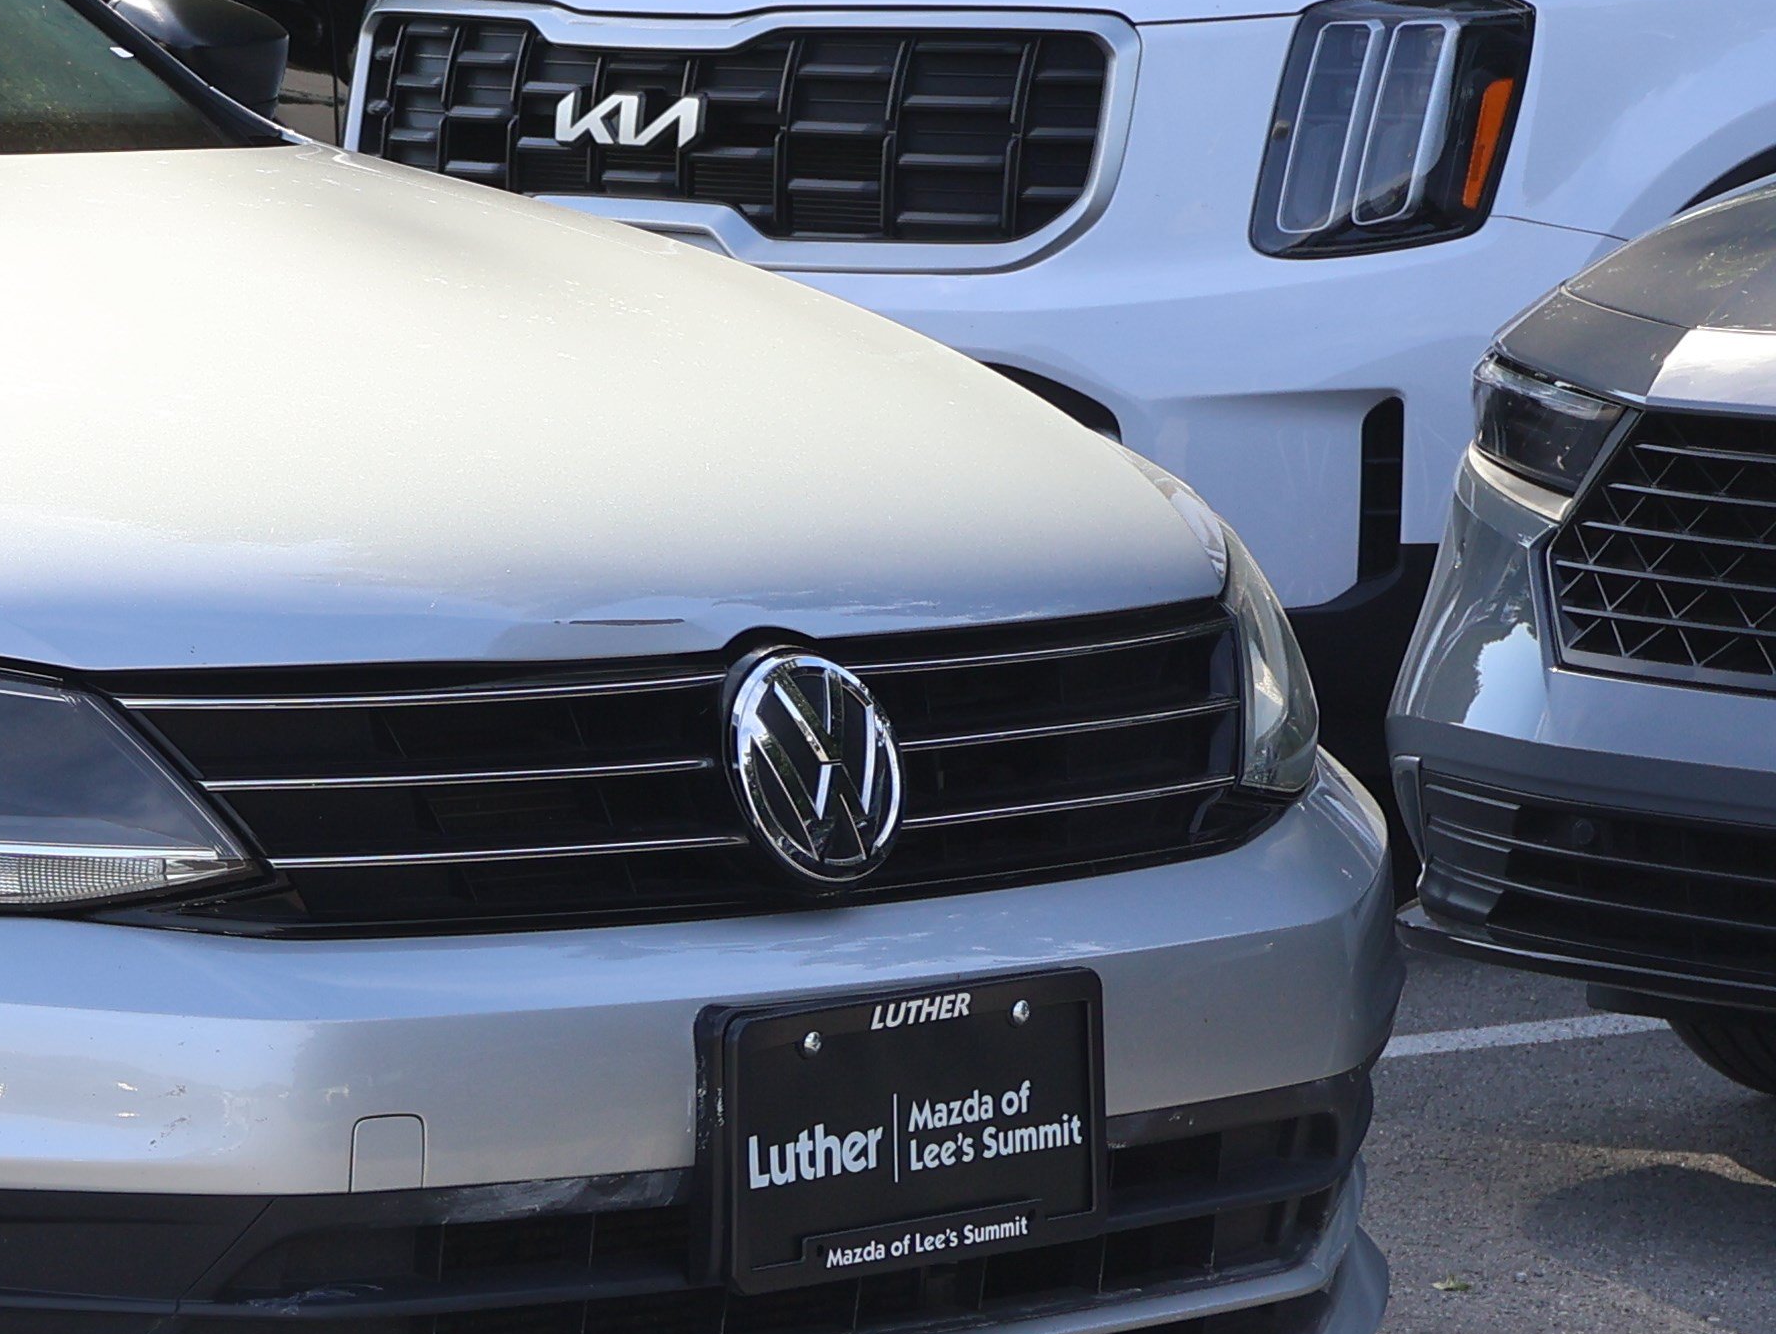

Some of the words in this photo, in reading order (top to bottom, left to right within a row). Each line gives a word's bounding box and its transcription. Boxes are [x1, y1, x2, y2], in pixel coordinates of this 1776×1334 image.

[555, 90, 700, 148] KIA
[870, 992, 971, 1031] LUTHER
[907, 1089, 994, 1133] Mazda
[1000, 1079, 1032, 1117] of
[748, 1123, 884, 1190] Luther
[909, 1129, 975, 1172] Lee's
[982, 1113, 1083, 1160] Summit
[826, 1239, 886, 1268] Mazda
[890, 1233, 912, 1258] of
[915, 1227, 959, 1253] Lee's
[963, 1216, 1028, 1245] Summit
